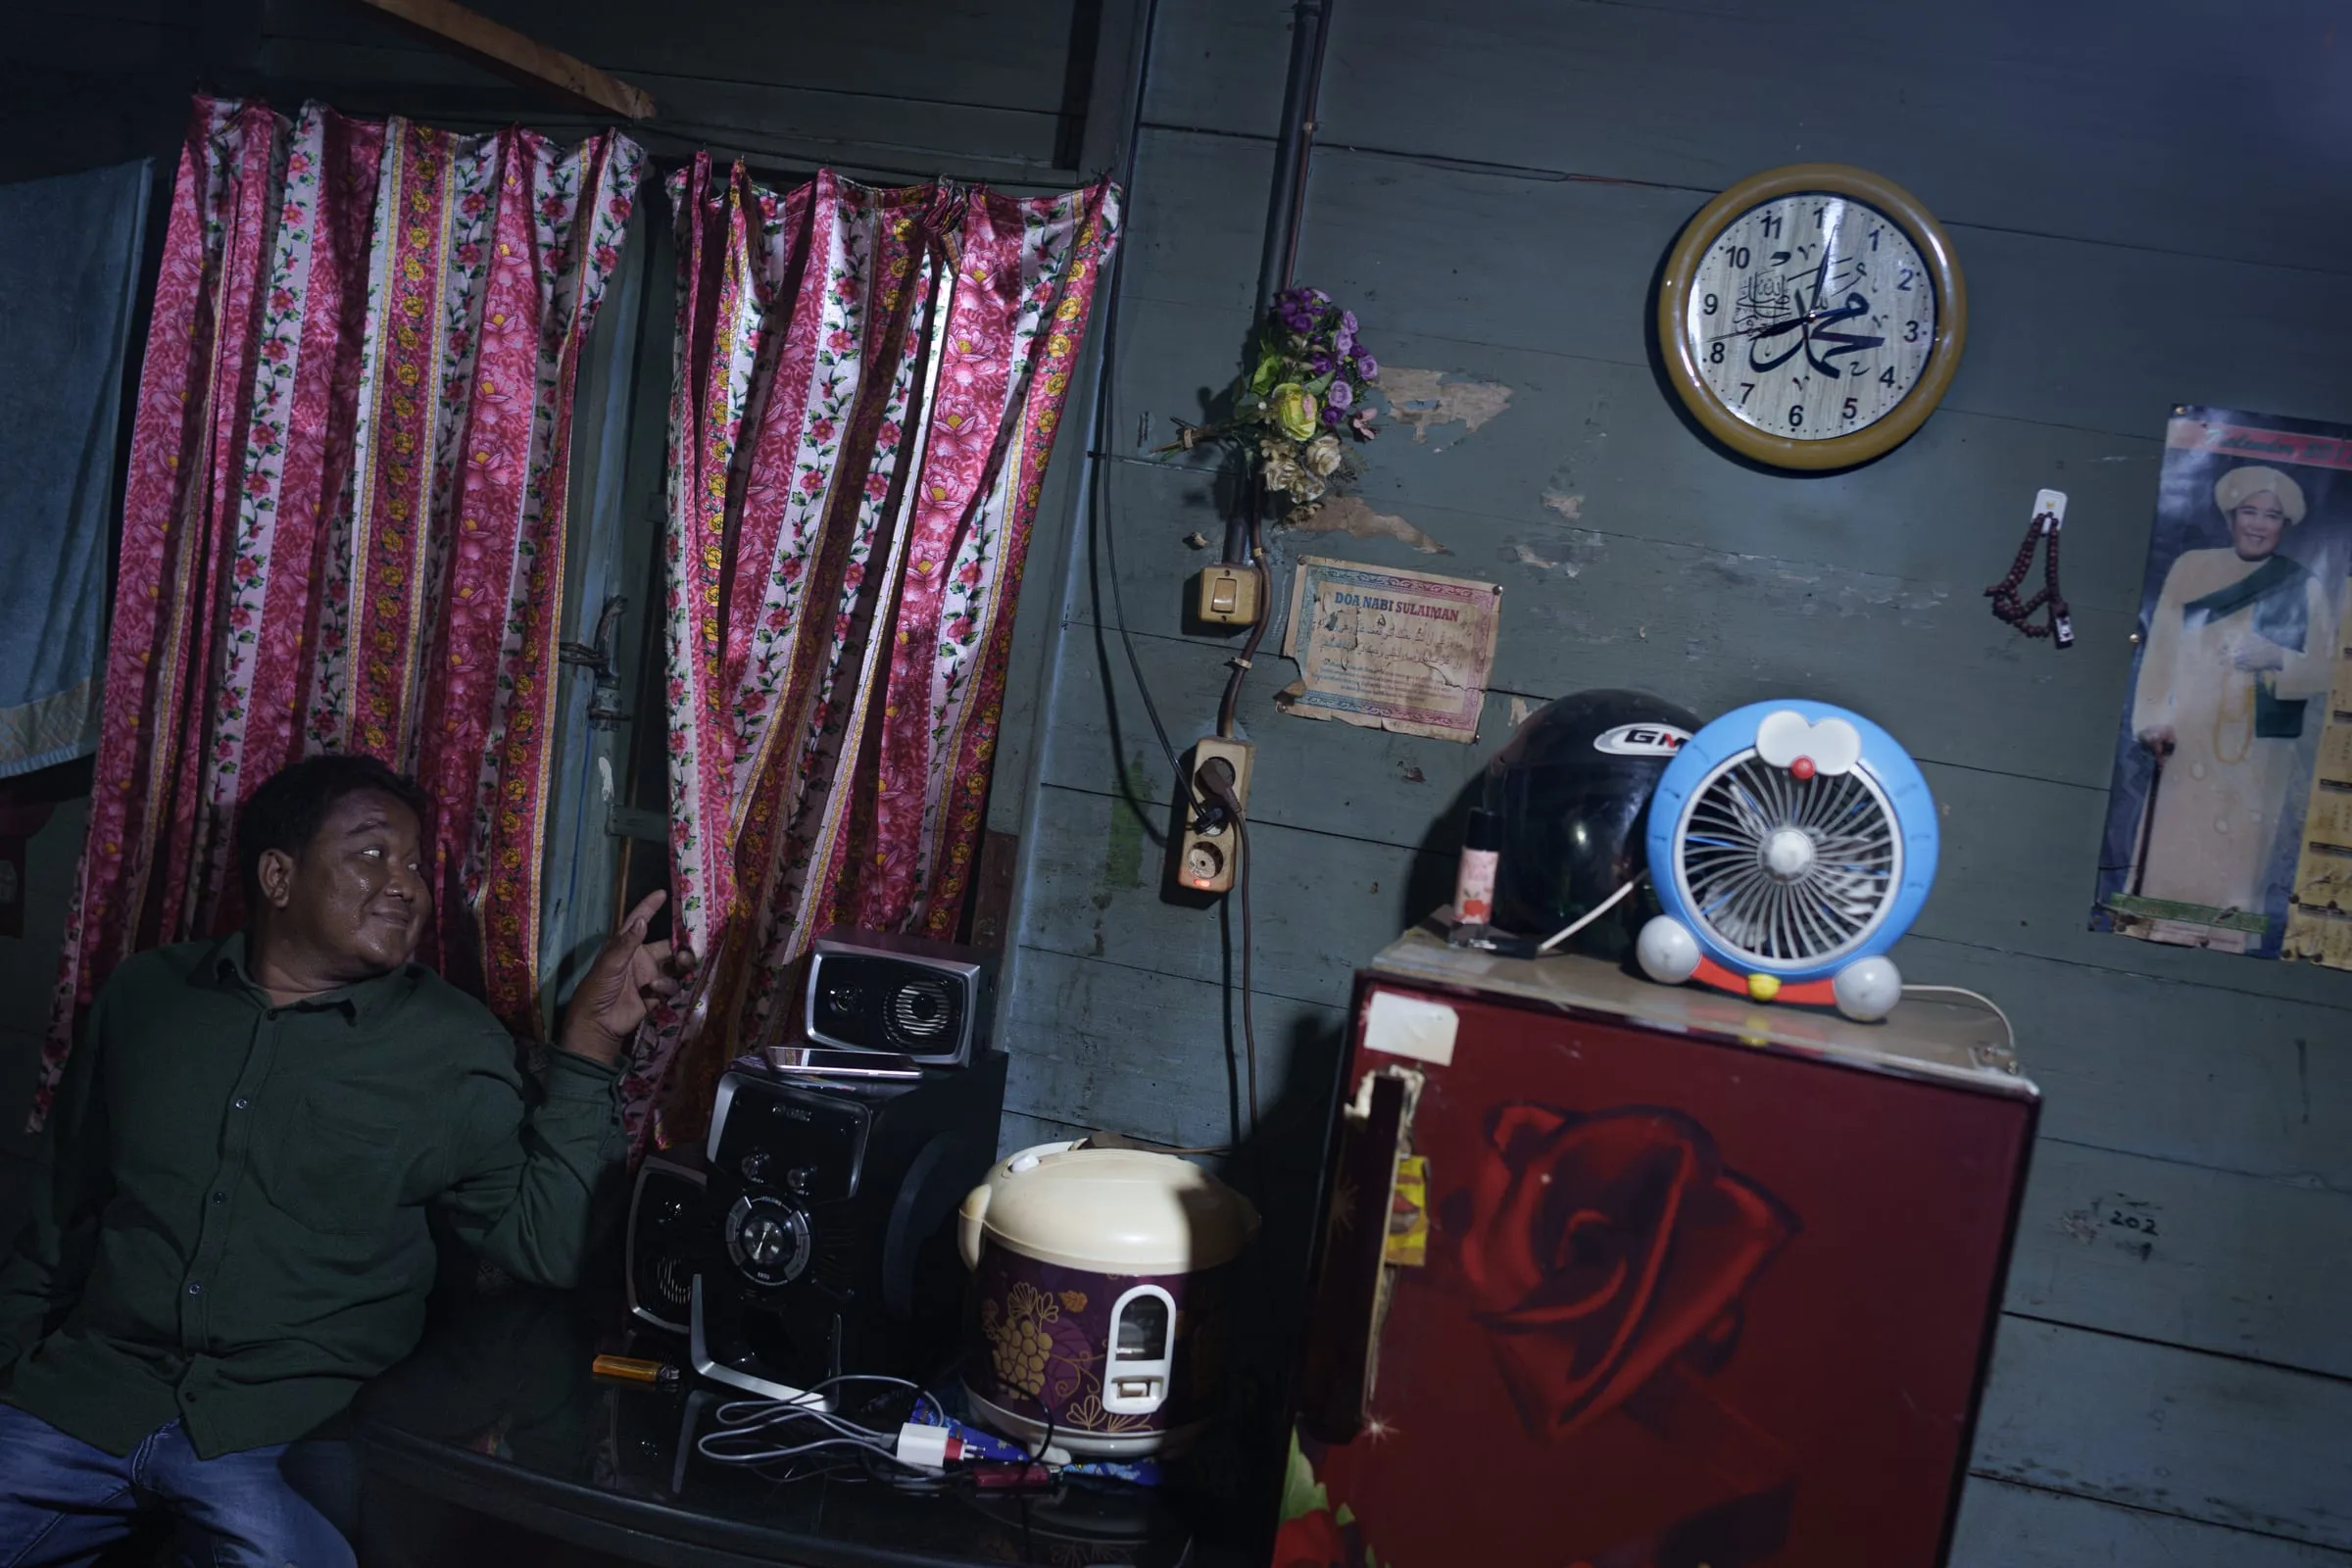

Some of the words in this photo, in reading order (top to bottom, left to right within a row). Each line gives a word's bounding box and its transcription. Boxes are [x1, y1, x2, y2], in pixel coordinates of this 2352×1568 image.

[1760, 215, 1783, 240] 11
[1869, 229, 1881, 252] 1
[1725, 245, 1750, 270] 10
[1897, 269, 1913, 292] 2
[1703, 294, 1718, 316] 9
[1904, 320, 1920, 342] 3
[1710, 342, 1725, 365] 8
[1880, 366, 1895, 388] 4
[1740, 383, 1755, 405] 7
[1788, 405, 1803, 426] 6
[1842, 398, 1858, 419] 5
[1335, 592, 1360, 607] DOA
[1363, 597, 1395, 612] NABI
[1396, 603, 1459, 622] SULAIMAN
